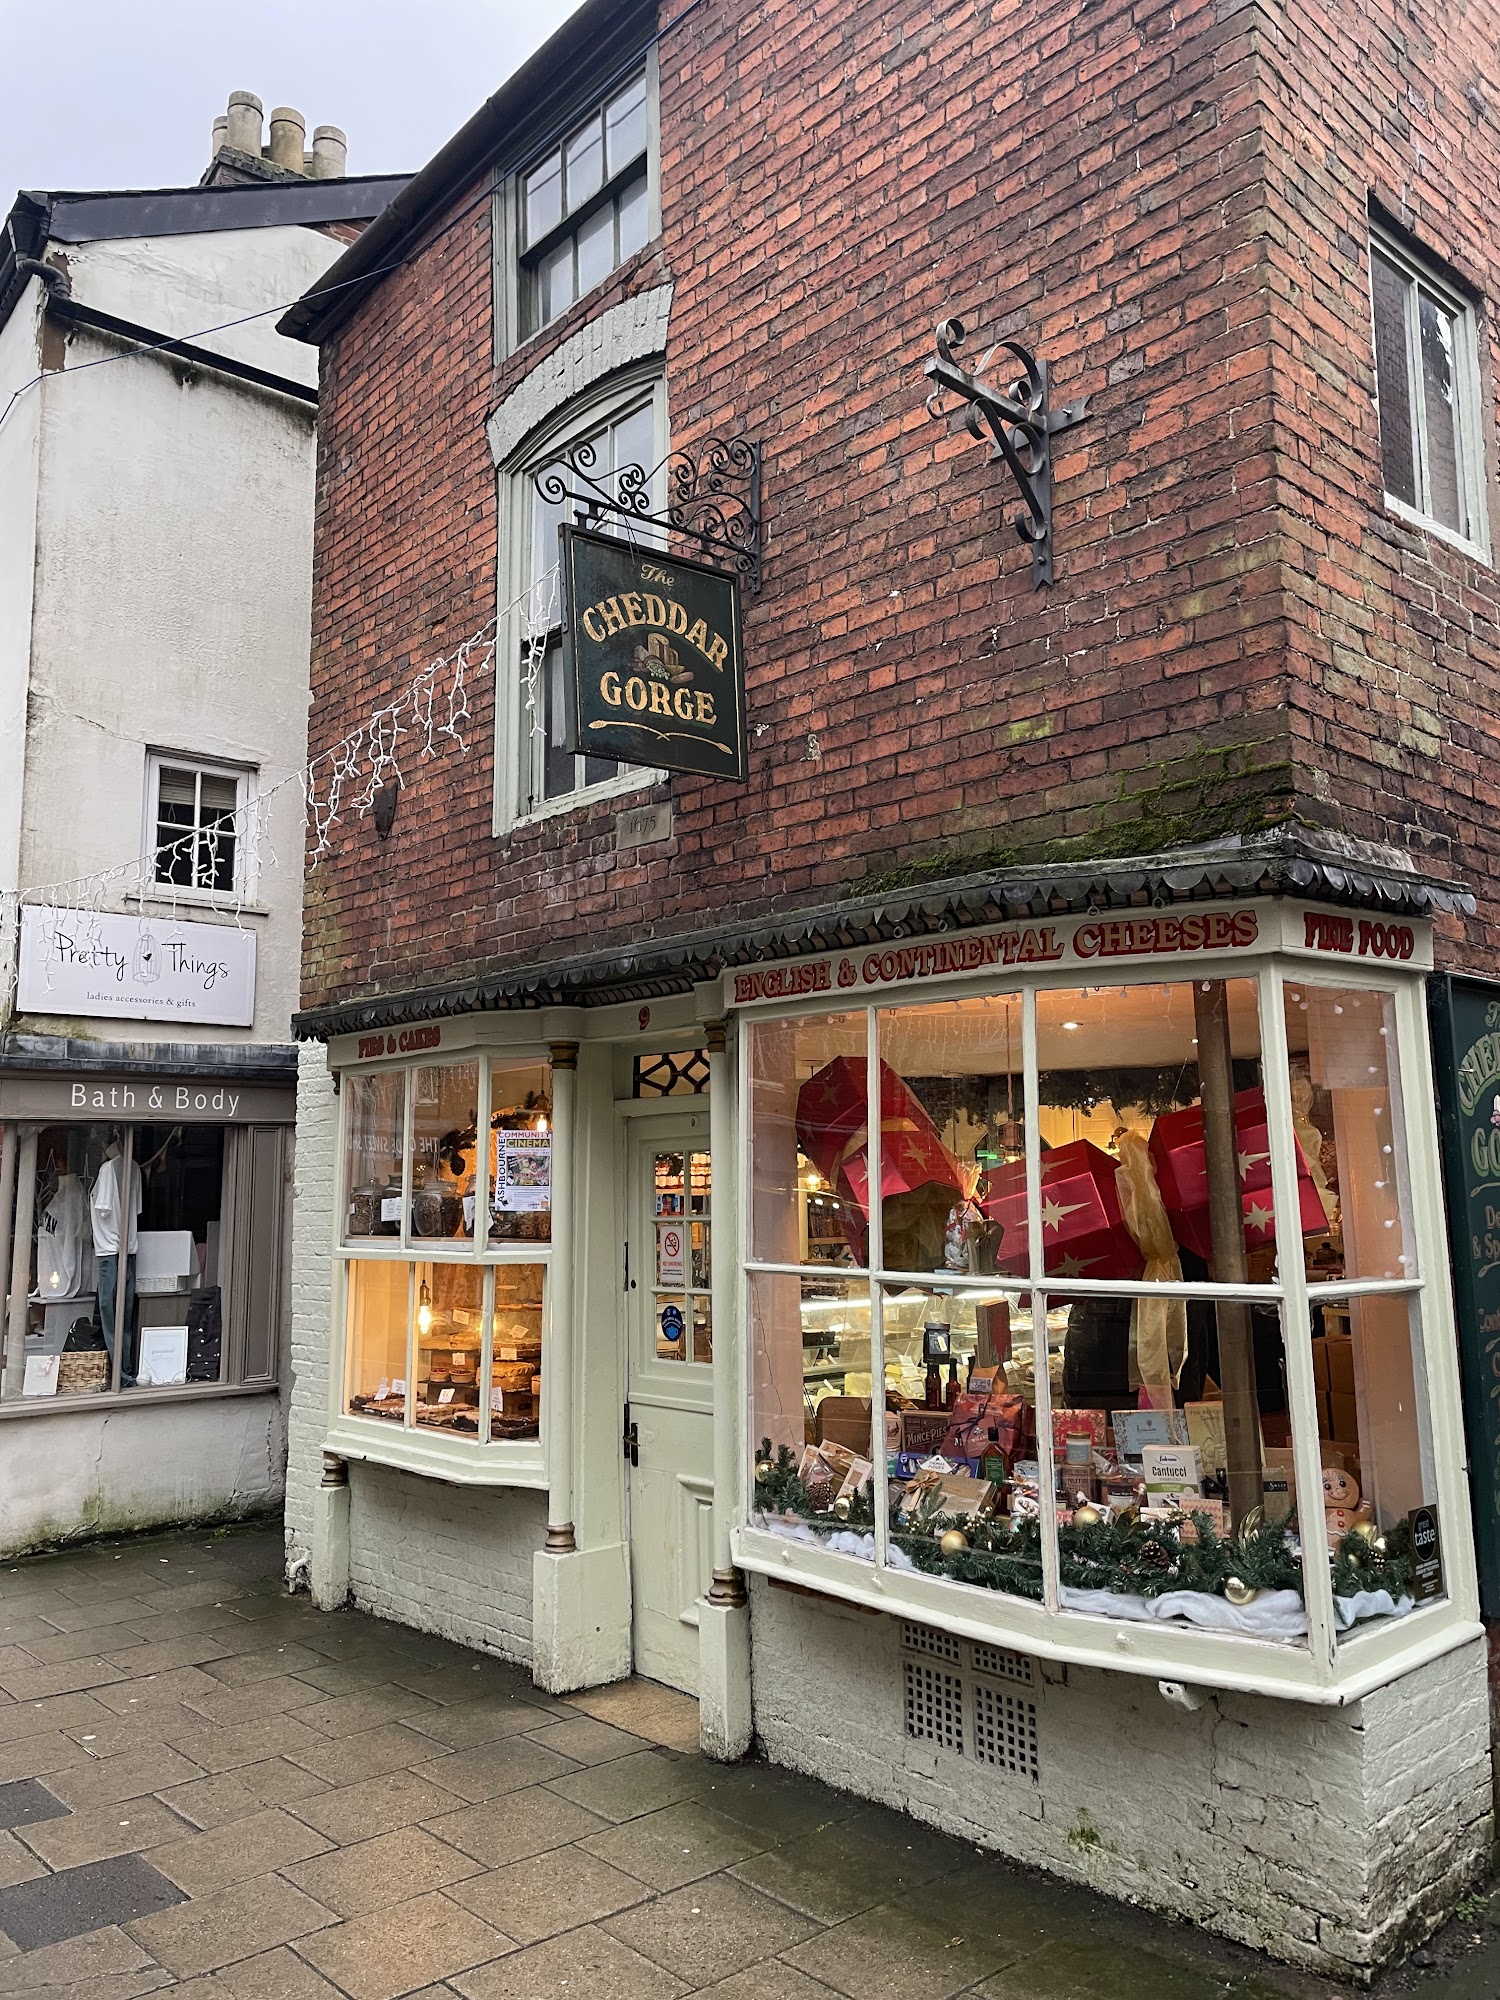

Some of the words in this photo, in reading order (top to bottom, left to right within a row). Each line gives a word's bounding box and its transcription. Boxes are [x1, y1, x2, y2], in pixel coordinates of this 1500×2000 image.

[640, 563, 675, 587] The
[582, 591, 729, 673] CHEDDAR
[600, 671, 718, 726] GORGE
[629, 815, 656, 835] 1675
[1303, 911, 1355, 953] FINE
[1358, 919, 1415, 960] FOOD
[54, 931, 129, 982] Pretty
[161, 942, 230, 990] Things
[734, 959, 831, 1003] ENGLISH
[837, 957, 857, 988] &
[862, 926, 1065, 985] CONTINENTAL
[1072, 909, 1259, 959] CHEESES
[86, 992, 113, 1003] ladies
[115, 995, 164, 1006] accessories
[166, 998, 174, 1006] &
[176, 998, 196, 1008] gifts
[639, 1005, 650, 1031] 9
[70, 1083, 136, 1108] Bath
[148, 1086, 163, 1109] &
[175, 1087, 240, 1116] Body
[498, 1131, 550, 1139] COMMUNITY
[506, 1139, 550, 1148] CINEMA
[497, 1138, 506, 1204] ASHBOURNE
[906, 1431, 930, 1448] MINCE
[930, 1427, 947, 1443] PIES
[1151, 1466, 1187, 1478] Cantucci
[1414, 1528, 1436, 1547] taste
[1417, 1519, 1430, 1533] great
